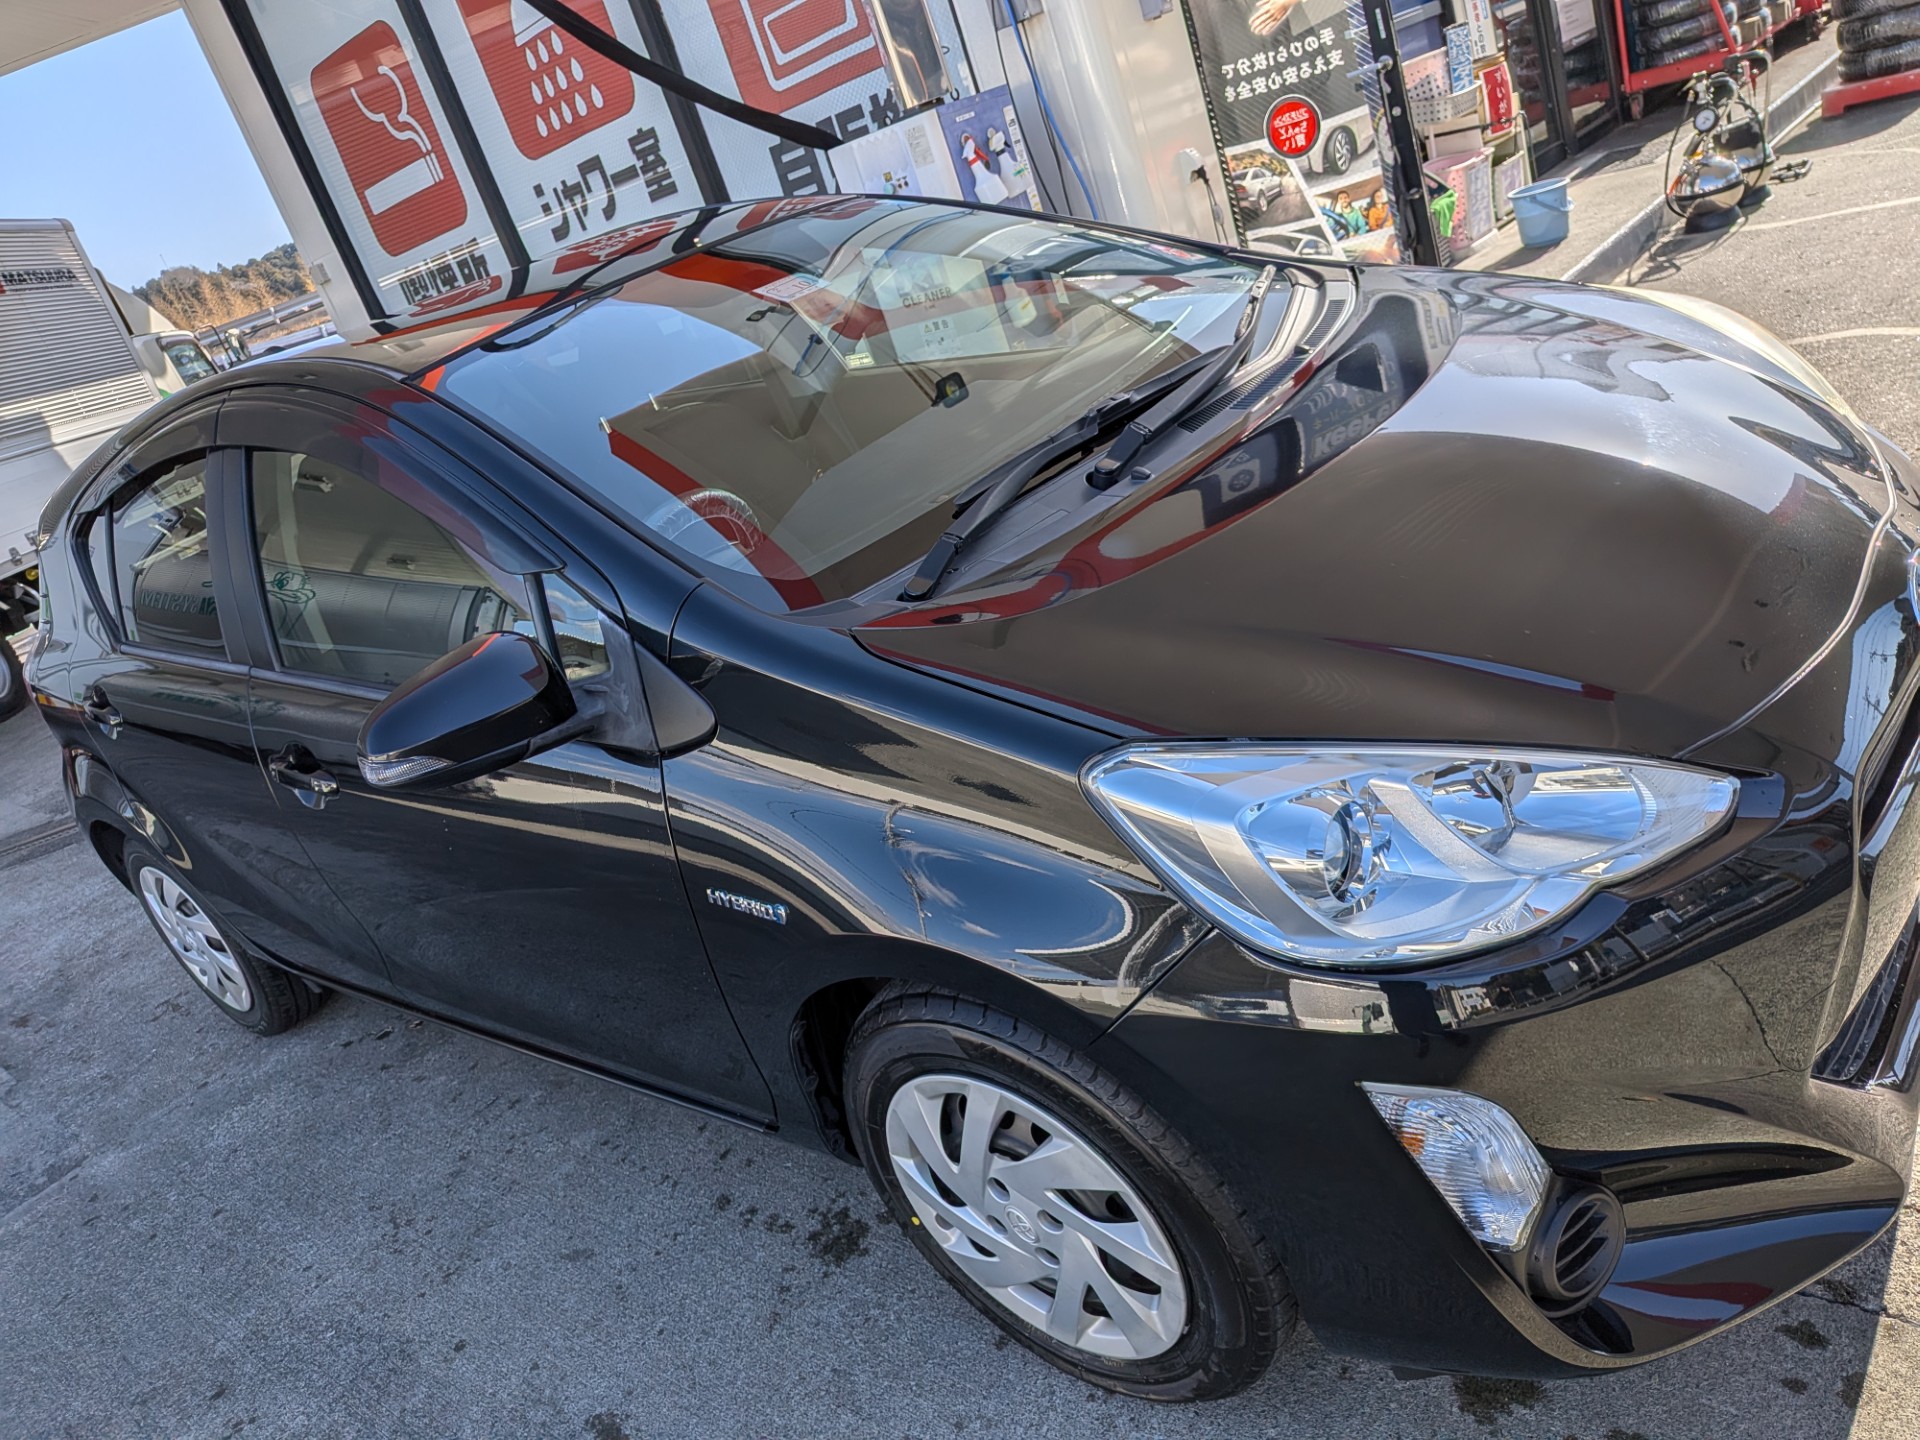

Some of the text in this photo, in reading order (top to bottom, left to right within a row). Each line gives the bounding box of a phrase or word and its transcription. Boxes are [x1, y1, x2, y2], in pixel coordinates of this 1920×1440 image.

[533, 126, 678, 243] シャワー室
[902, 286, 952, 308] CLEANER
[706, 888, 776, 920] HYBRID
